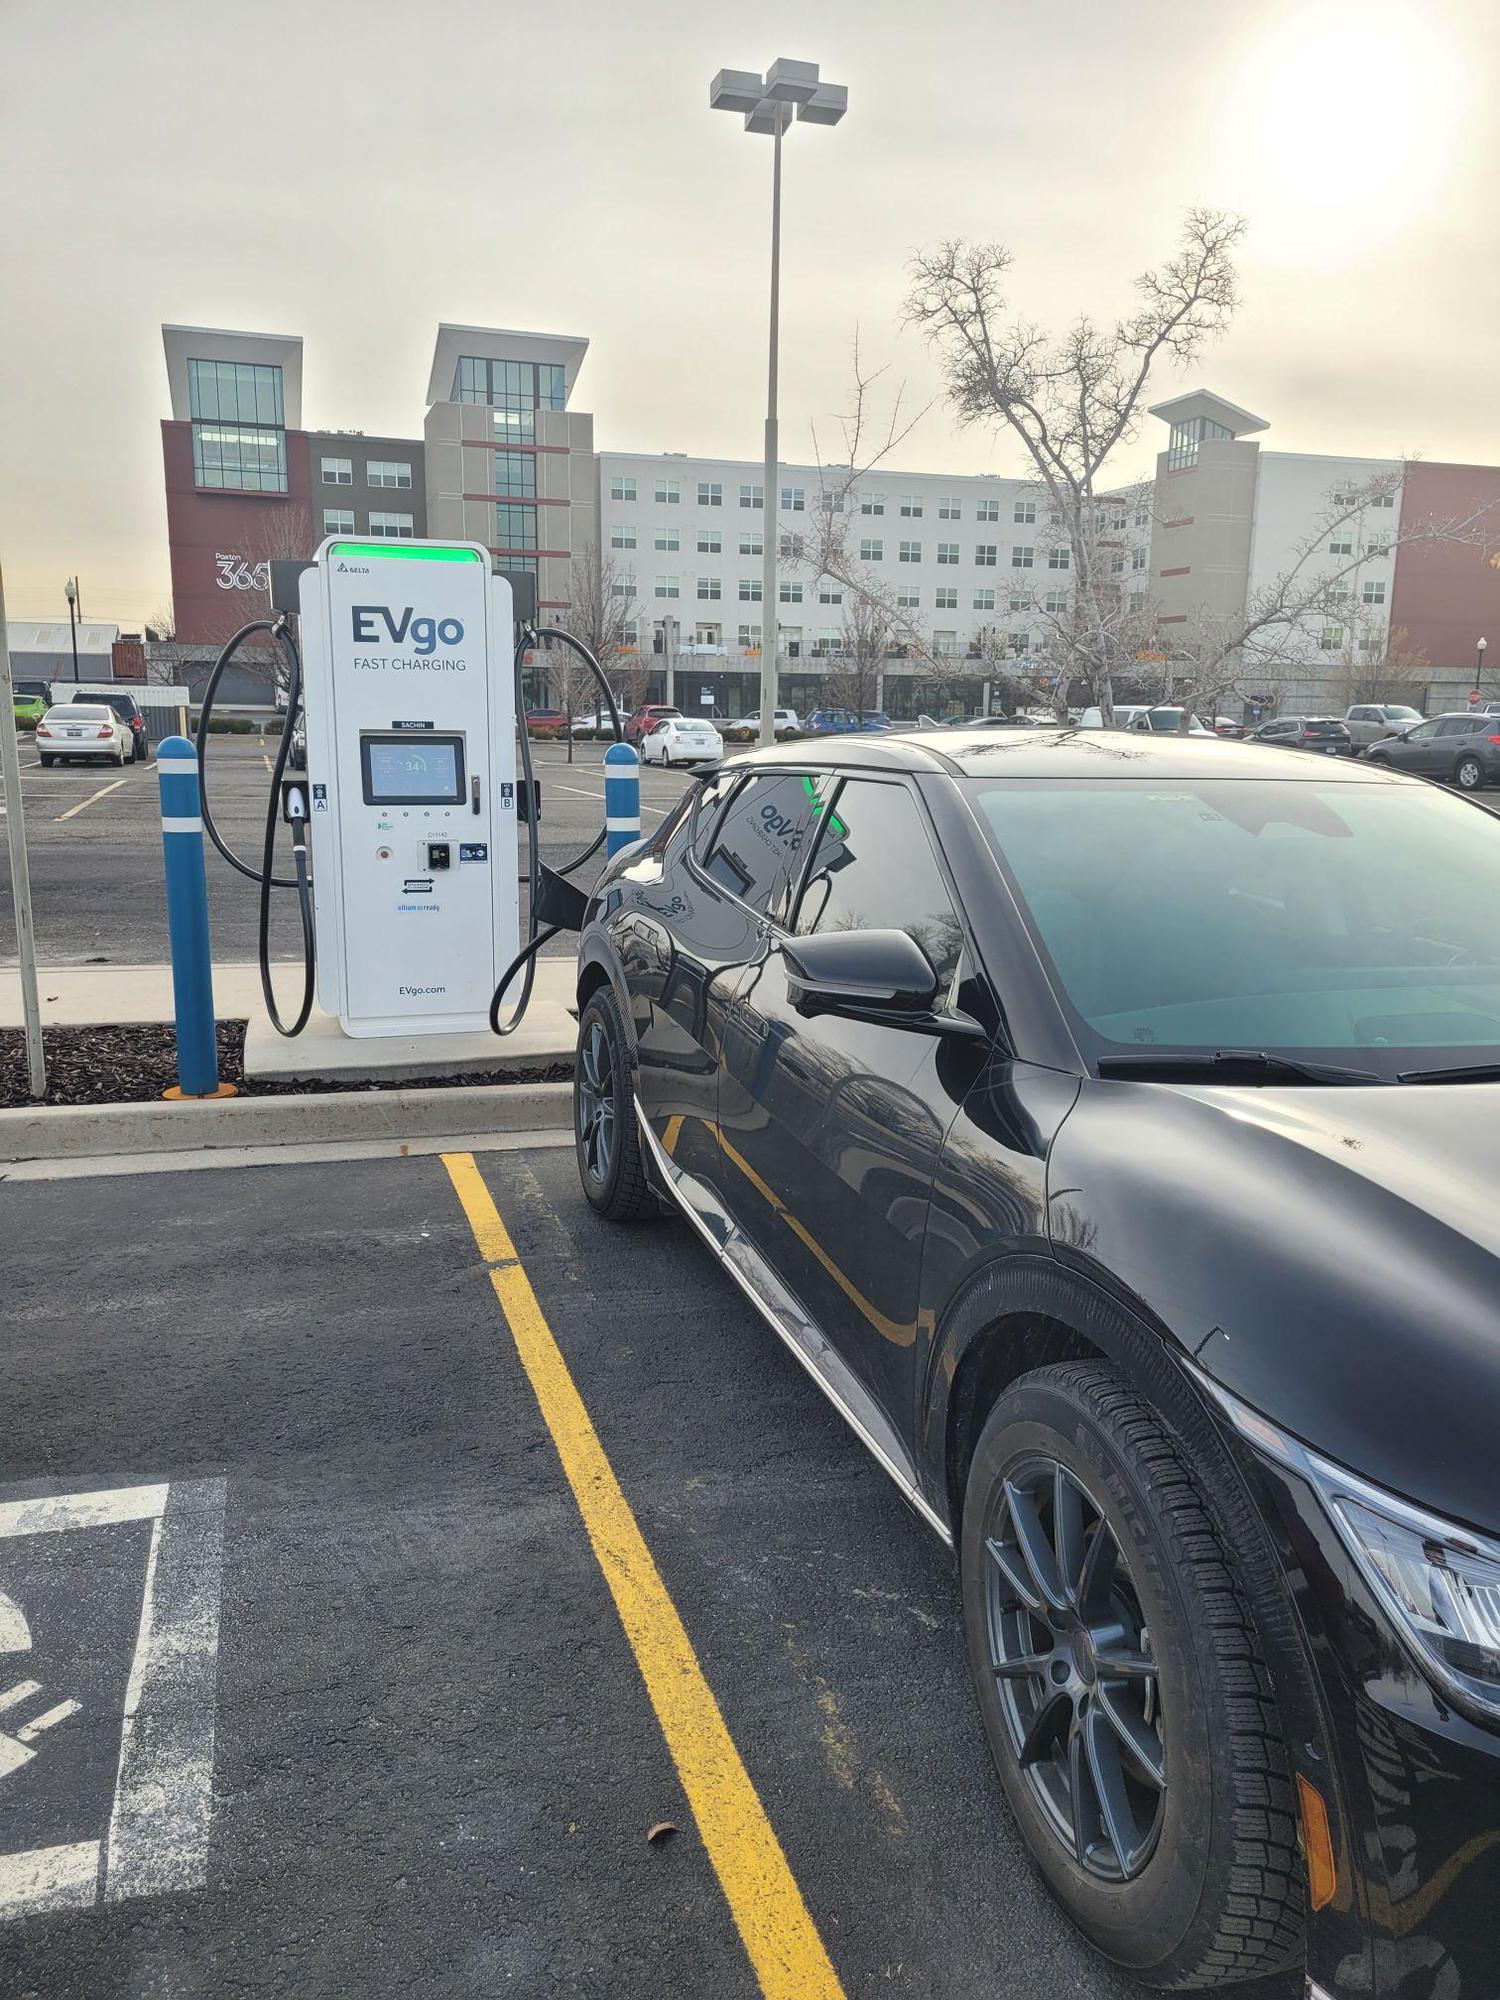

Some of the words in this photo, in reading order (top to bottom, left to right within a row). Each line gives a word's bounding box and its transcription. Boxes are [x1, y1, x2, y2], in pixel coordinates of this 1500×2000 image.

[215, 552, 241, 561] Paxton
[216, 560, 270, 591] 365
[351, 605, 465, 656] EVgo
[353, 657, 388, 671] FAST
[391, 658, 466, 672] CHARGING
[400, 721, 426, 729] SACHIN
[316, 799, 326, 811] A
[504, 798, 511, 808] B
[399, 986, 446, 997] EVgo.com
